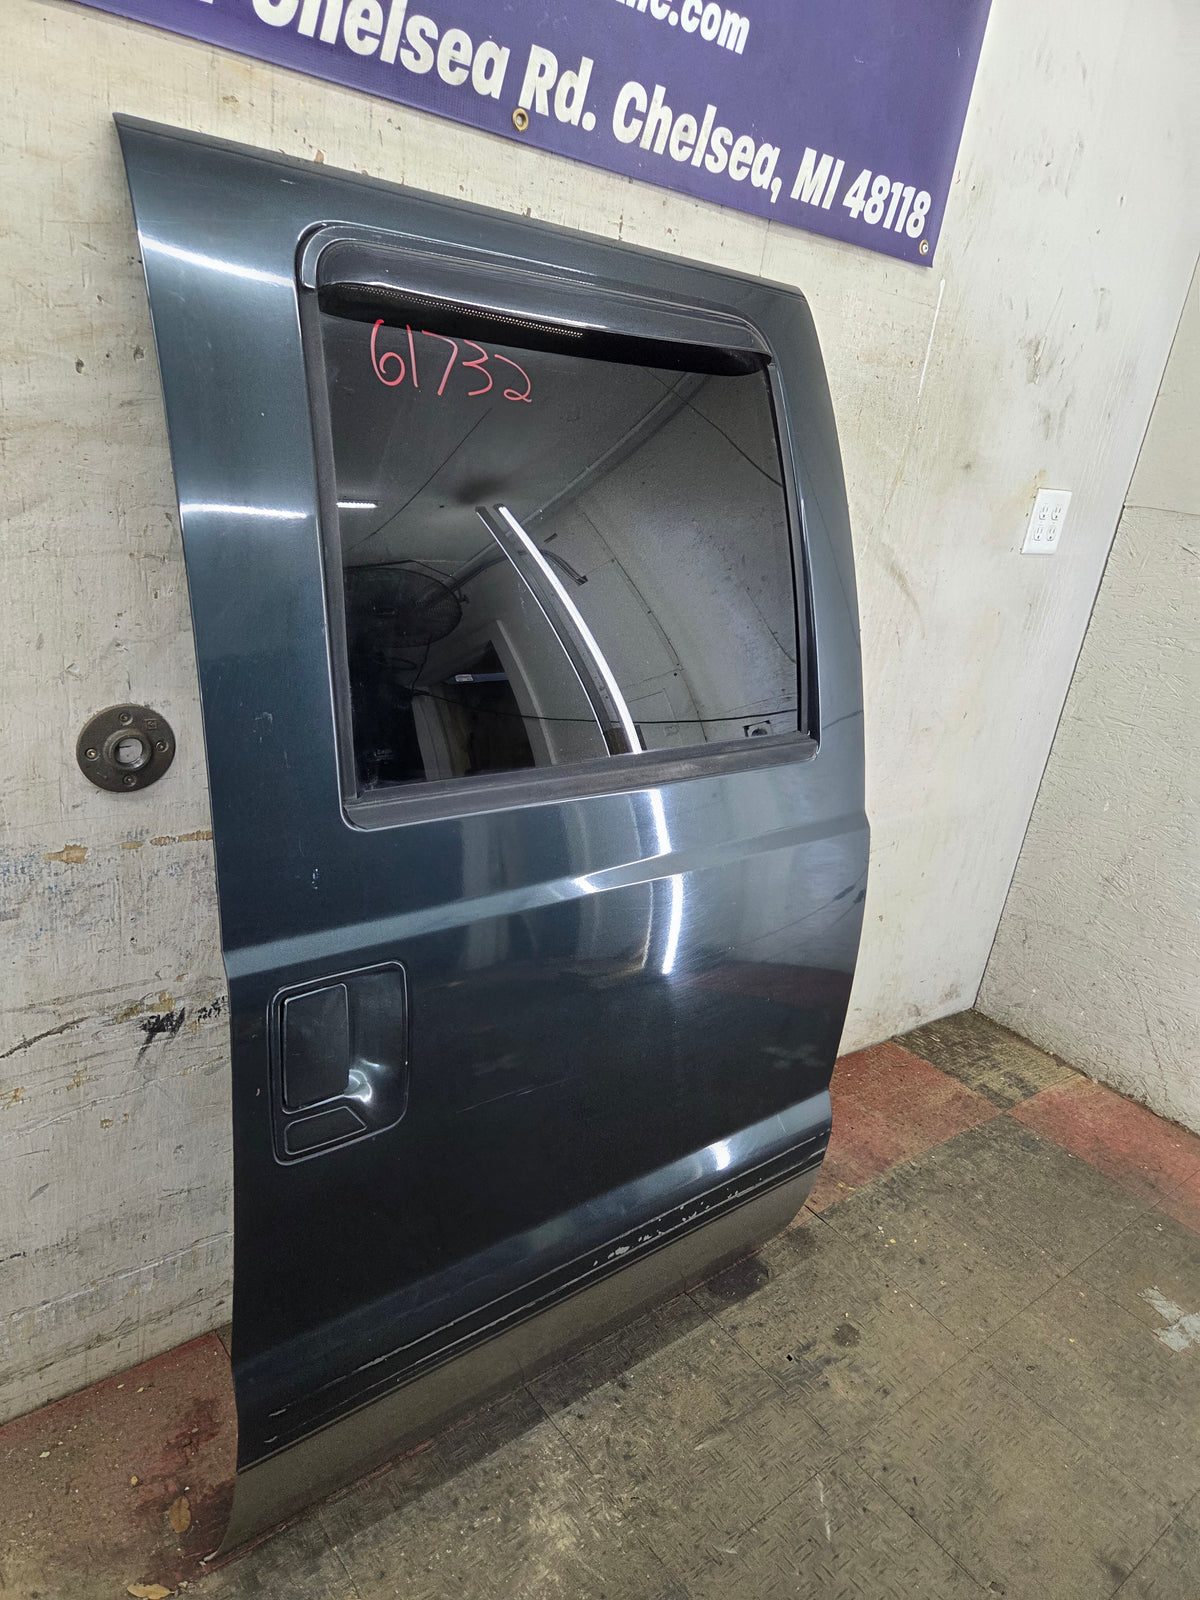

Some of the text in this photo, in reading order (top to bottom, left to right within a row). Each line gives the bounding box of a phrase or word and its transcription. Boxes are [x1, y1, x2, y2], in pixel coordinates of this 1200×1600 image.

[615, 0, 750, 55] c.com
[517, 43, 597, 132] Rd.
[612, 80, 783, 204] Chelsea,
[790, 146, 845, 210] MI
[842, 168, 932, 238] 48118
[370, 318, 533, 403] 61732
